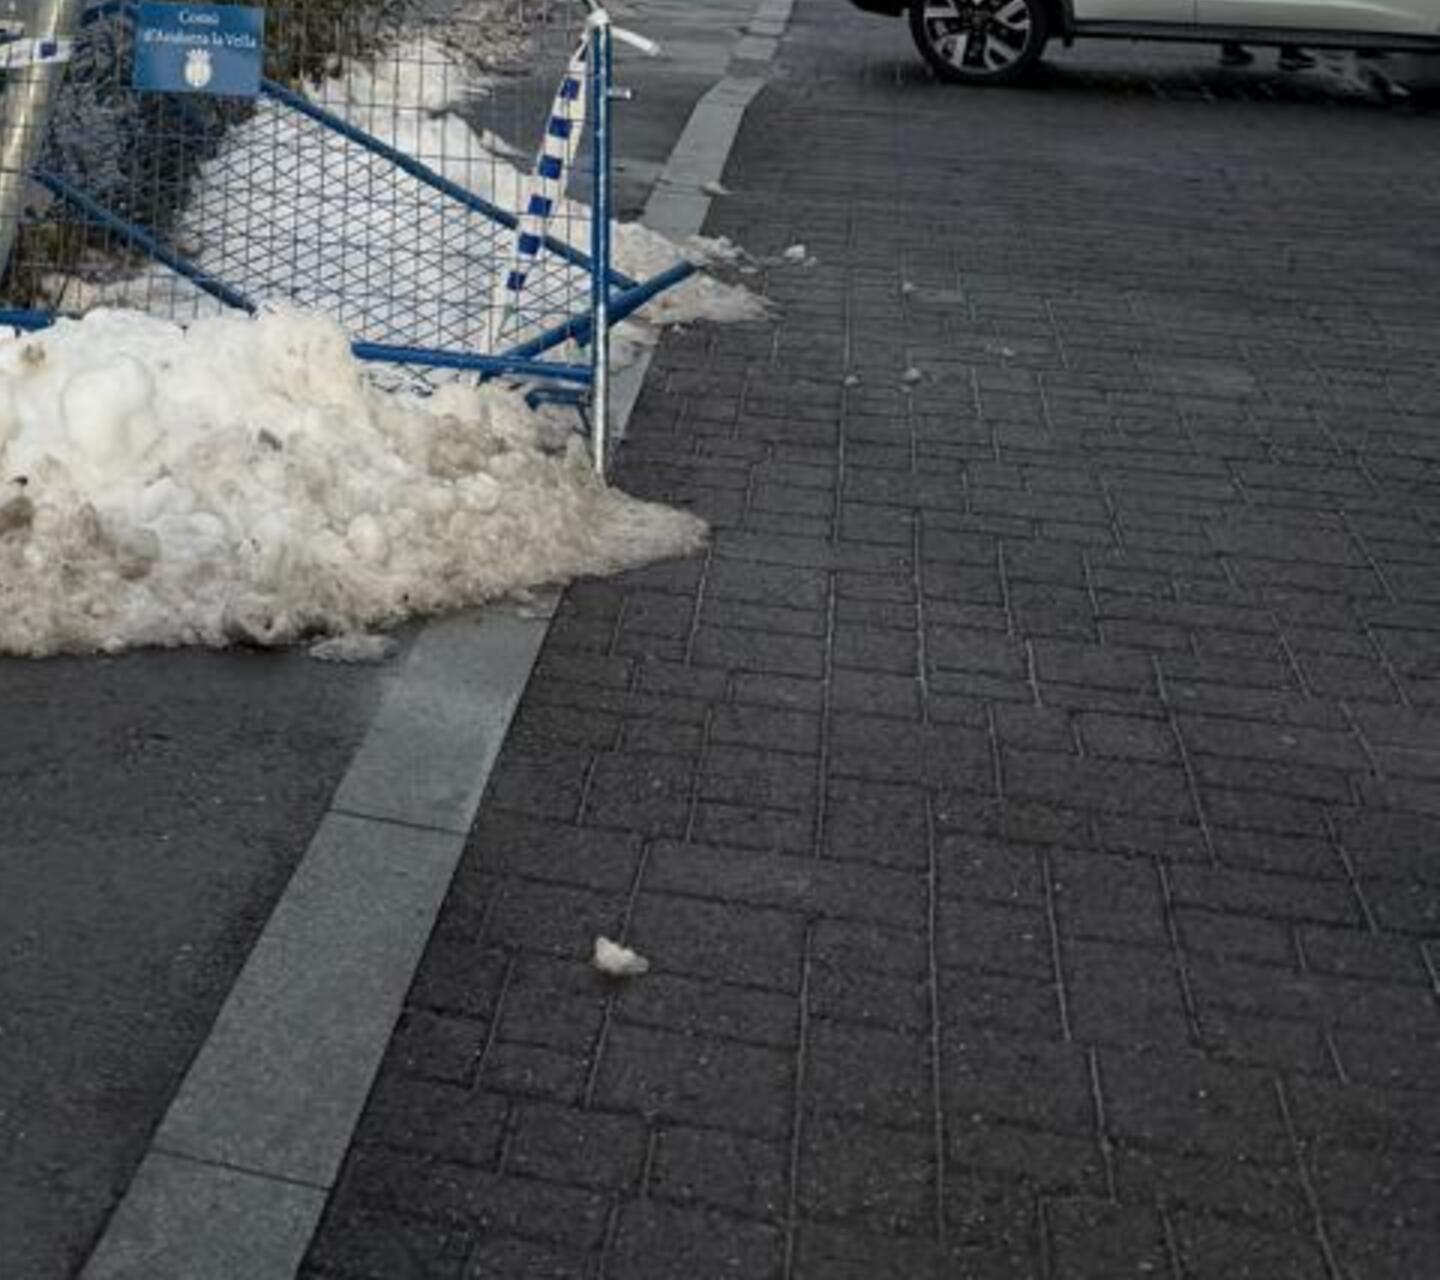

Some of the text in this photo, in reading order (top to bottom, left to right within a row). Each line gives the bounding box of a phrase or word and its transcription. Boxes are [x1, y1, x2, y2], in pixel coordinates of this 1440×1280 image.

[179, 9, 220, 24] Comú
[212, 31, 223, 45] la
[224, 32, 257, 48] Vella
